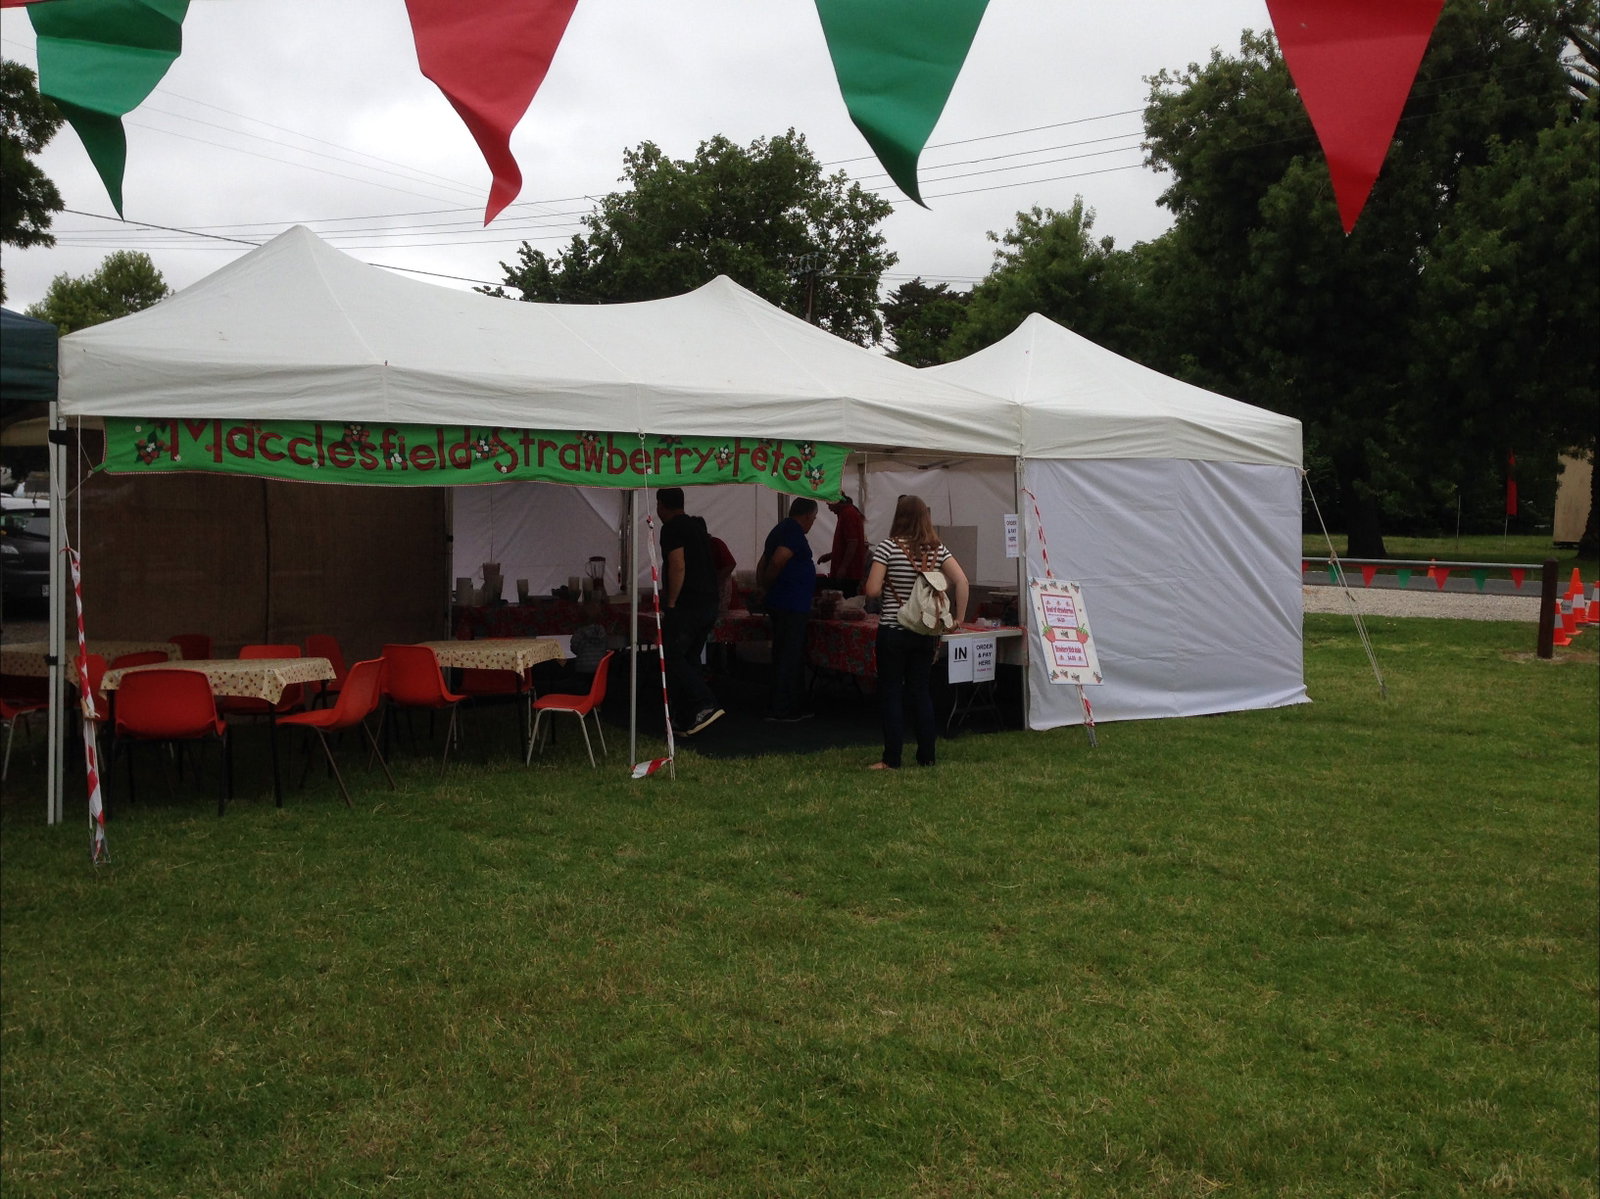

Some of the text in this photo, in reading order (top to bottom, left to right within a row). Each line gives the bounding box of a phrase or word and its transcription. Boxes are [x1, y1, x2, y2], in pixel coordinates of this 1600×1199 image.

[169, 418, 471, 471] Macclesfield
[492, 428, 717, 475] Strawberry
[954, 646, 968, 660] IN
